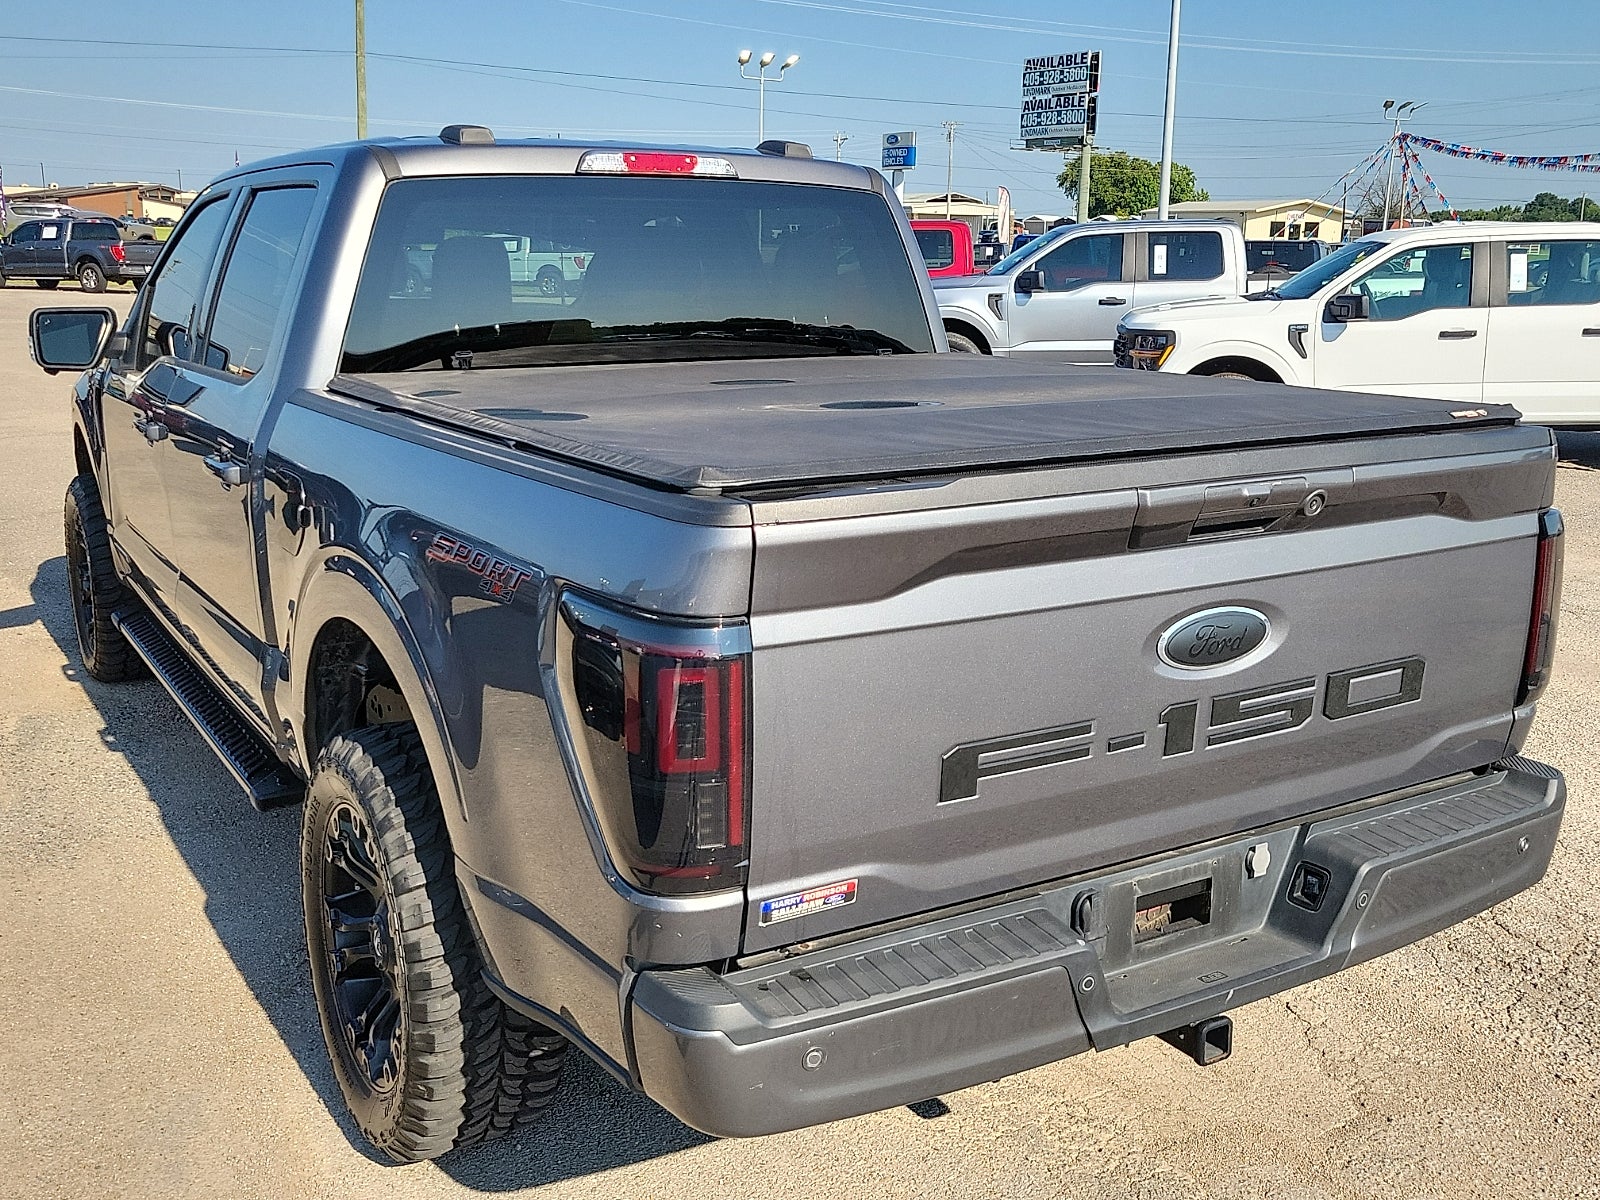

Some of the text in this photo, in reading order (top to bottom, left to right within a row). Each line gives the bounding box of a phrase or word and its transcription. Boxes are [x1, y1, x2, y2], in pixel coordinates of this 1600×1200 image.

[1025, 52, 1088, 71] AVAILABLE
[1023, 67, 1087, 86] 405-928-5800
[1023, 86, 1051, 97] LINDMARK
[1023, 96, 1085, 112] AVAILABLE
[1021, 110, 1085, 127] 405-928-5800
[1020, 127, 1049, 138] LINDMARK
[426, 531, 534, 592] SPORT
[1188, 623, 1250, 658] Ford
[937, 655, 1427, 807] F-150
[771, 884, 849, 910] HARRY ROBINSON
